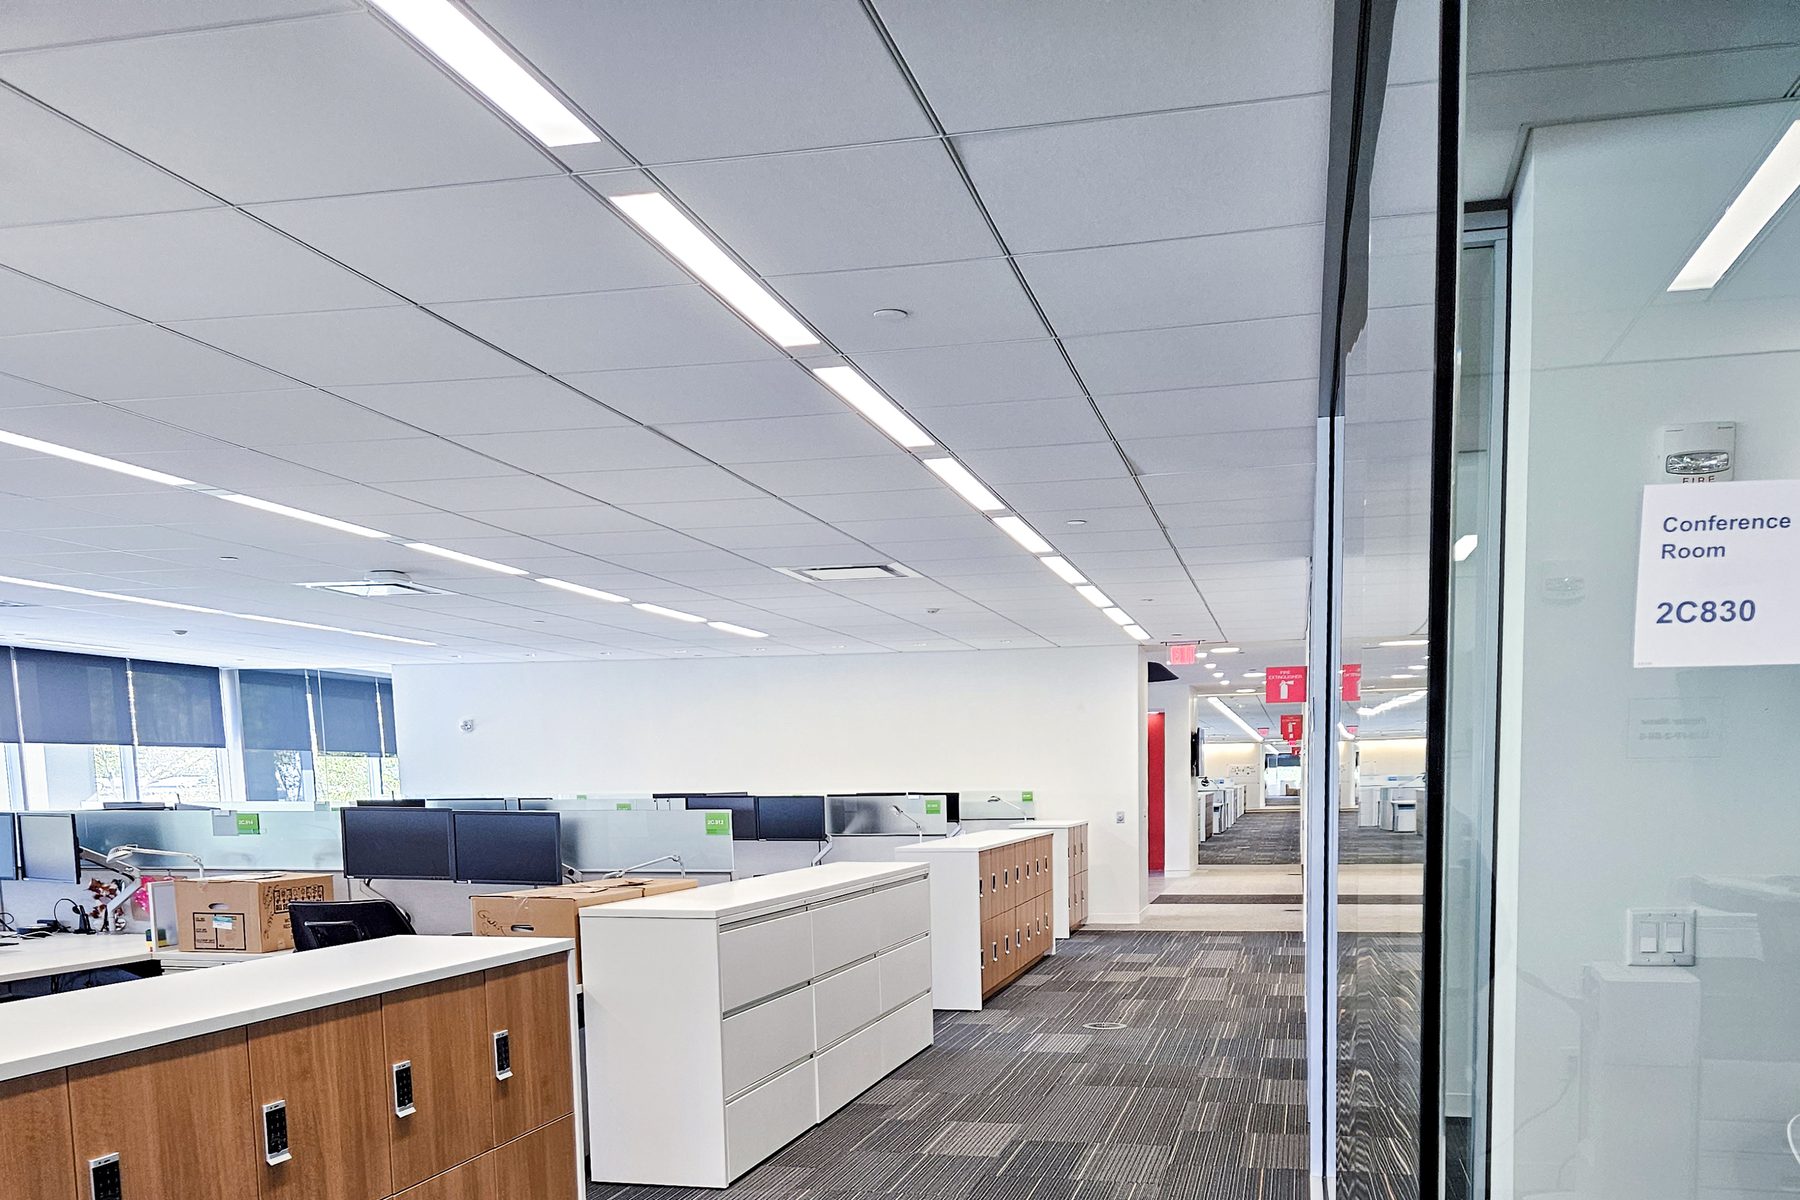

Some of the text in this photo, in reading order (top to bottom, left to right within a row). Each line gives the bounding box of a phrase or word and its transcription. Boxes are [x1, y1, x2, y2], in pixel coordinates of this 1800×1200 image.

[1663, 515, 1791, 532] Conference
[1661, 544, 1726, 559] Room
[1656, 600, 1755, 624] 2C830
